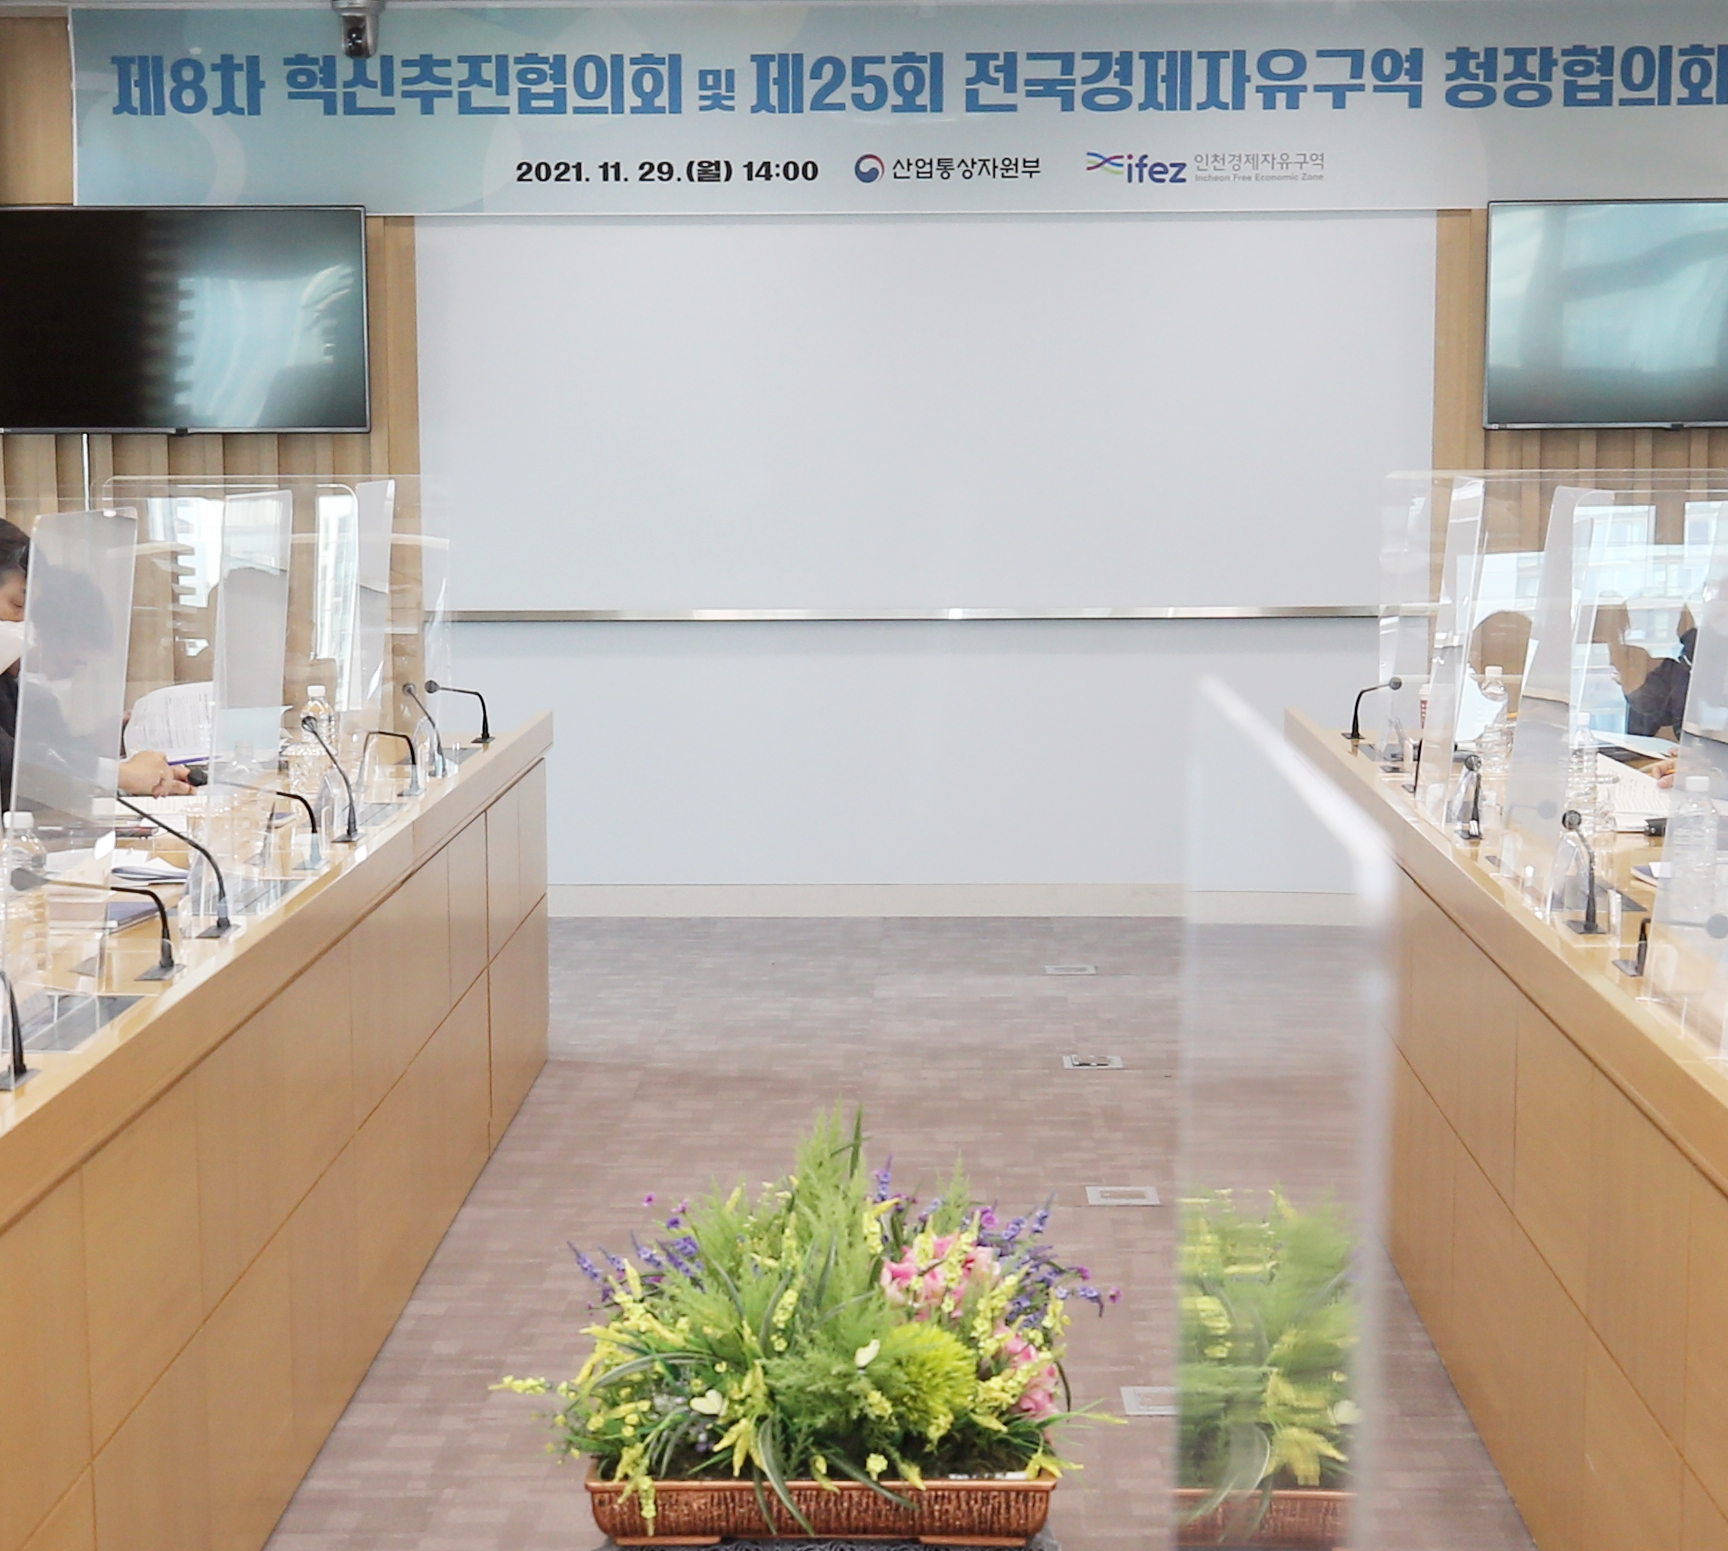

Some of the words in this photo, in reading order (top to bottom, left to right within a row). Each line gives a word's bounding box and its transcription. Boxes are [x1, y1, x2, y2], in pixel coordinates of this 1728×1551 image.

[112, 54, 266, 116] 제8차
[284, 53, 682, 116] 혁신추진협의회
[698, 69, 735, 112] 및
[750, 51, 943, 114] 제25회
[965, 48, 1423, 113] 전국경제자유구역
[516, 160, 591, 182] 2021.
[598, 160, 629, 182] 11.
[742, 160, 820, 182] 14:00
[892, 156, 1042, 180] 산업통상자원부
[1126, 153, 1187, 184] ifez
[1193, 152, 1325, 172] 인천경제자유구역
[1194, 173, 1231, 182] Incheon
[1233, 173, 1253, 182] Free
[1255, 173, 1299, 182] Economic
[1301, 172, 1324, 181] Zone
